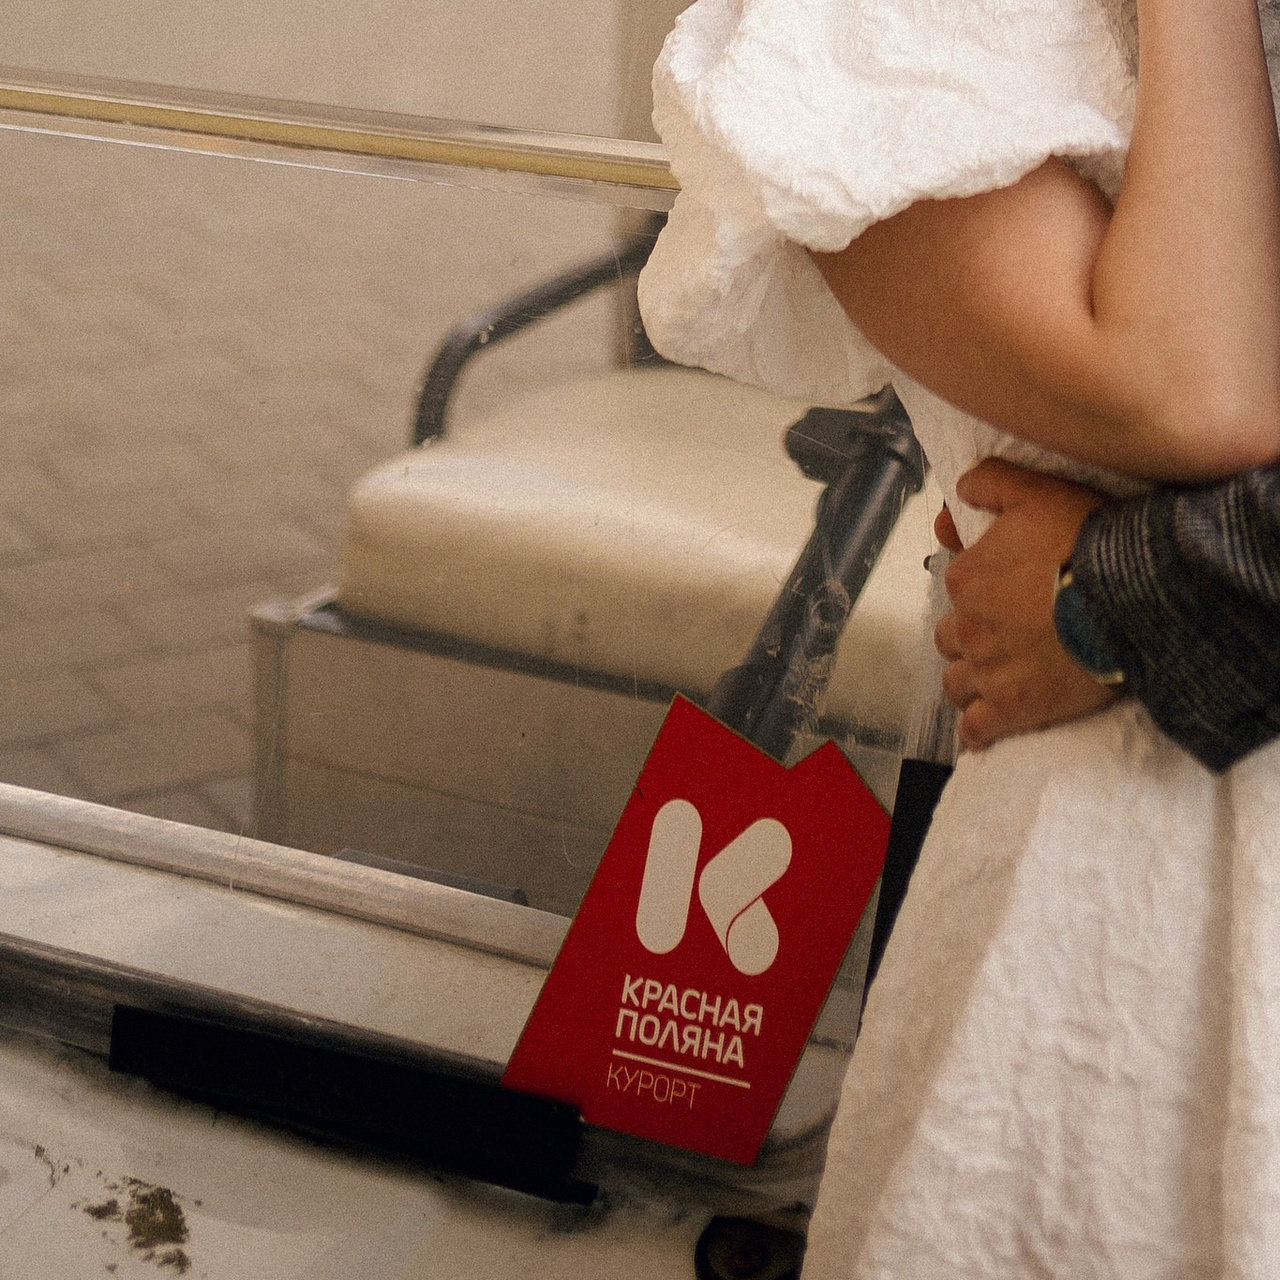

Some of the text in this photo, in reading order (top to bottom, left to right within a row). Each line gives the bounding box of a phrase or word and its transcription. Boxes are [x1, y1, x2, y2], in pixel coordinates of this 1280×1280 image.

[621, 974, 763, 1036] КРАСНАЯ
[615, 1008, 744, 1068] ПОЛЯНА
[606, 1063, 701, 1110] КУРОРТ
